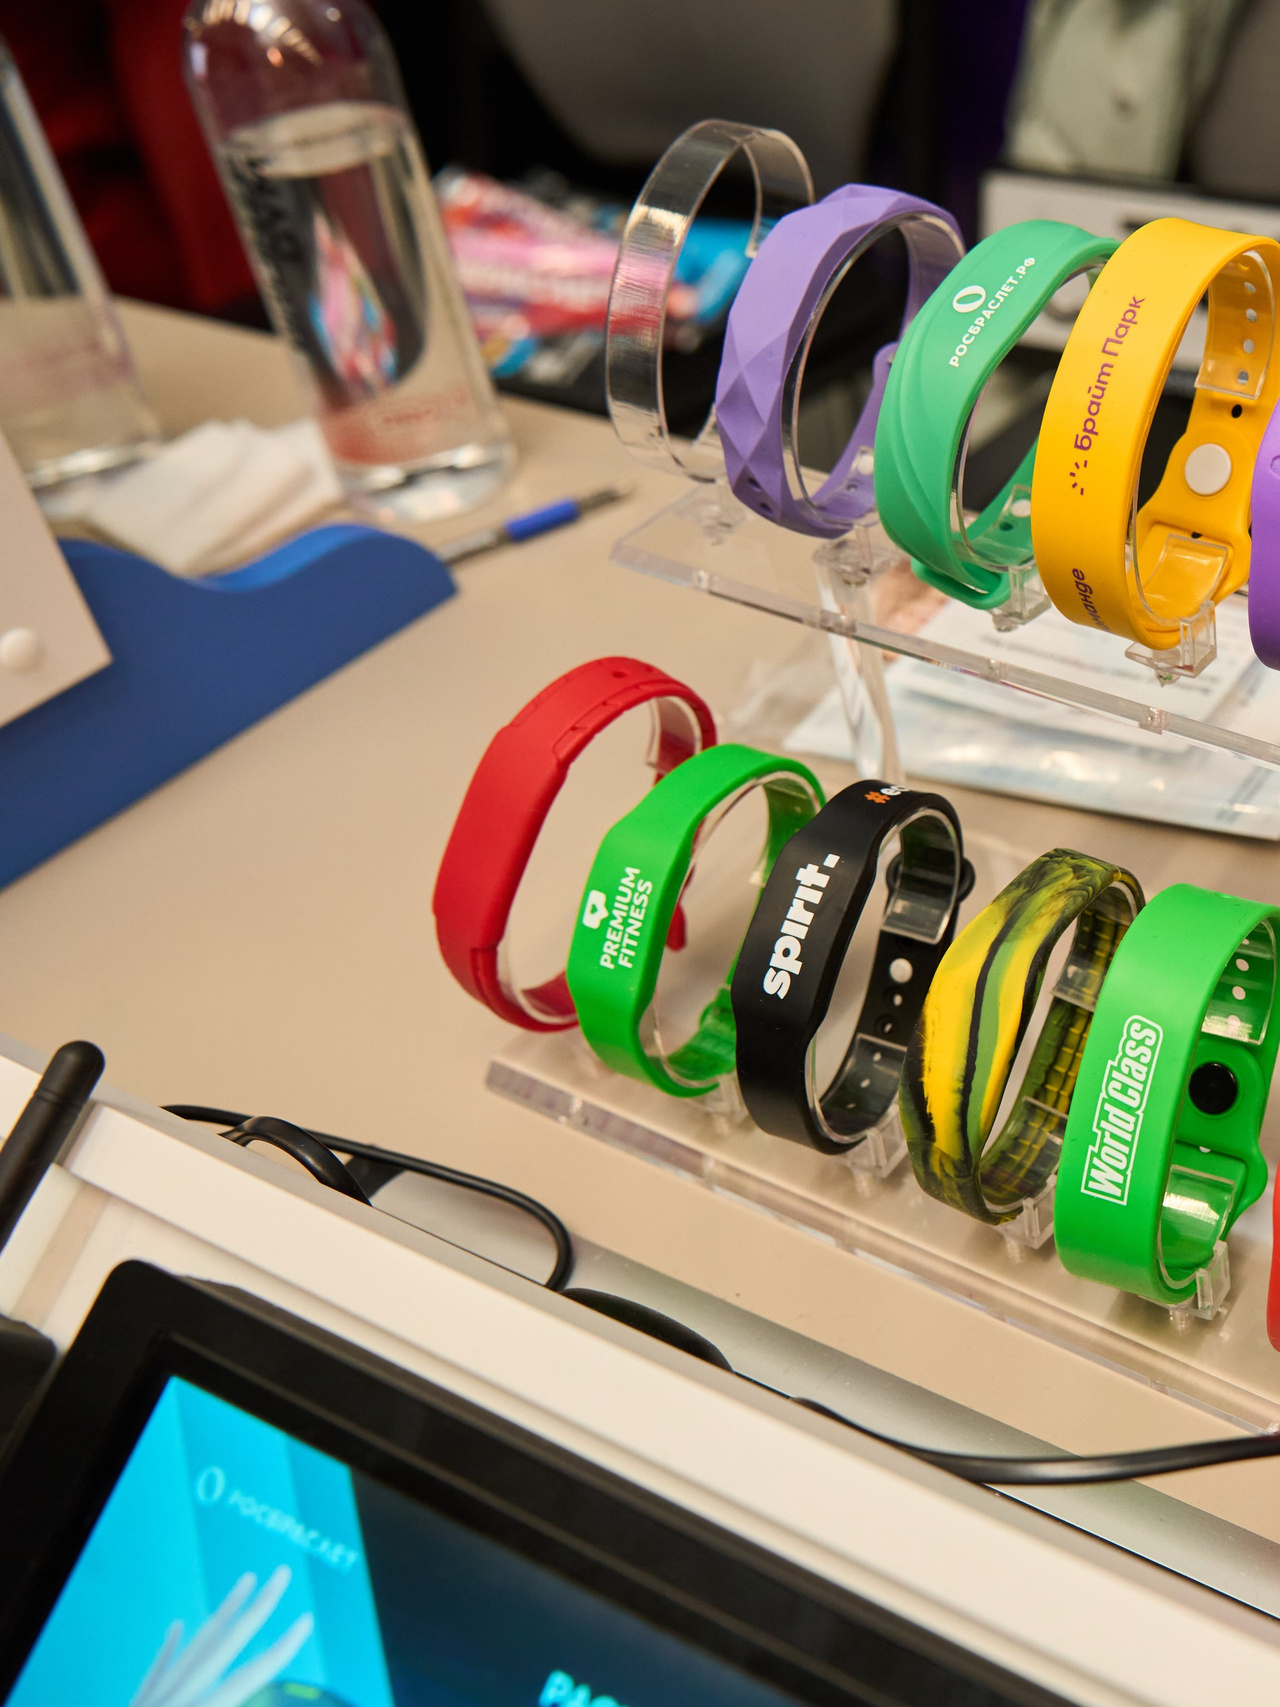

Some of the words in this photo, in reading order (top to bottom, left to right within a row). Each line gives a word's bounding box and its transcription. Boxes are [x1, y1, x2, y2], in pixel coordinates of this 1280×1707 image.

[949, 257, 1036, 368] РОСБРАСЛЕТ.РФ
[1074, 361, 1115, 451] Брайт
[1101, 296, 1146, 357] Парк
[600, 866, 641, 970] PREMIUM
[618, 881, 653, 969] FITNESS
[1107, 1022, 1157, 1108] Class
[1088, 1102, 1137, 1197] World
